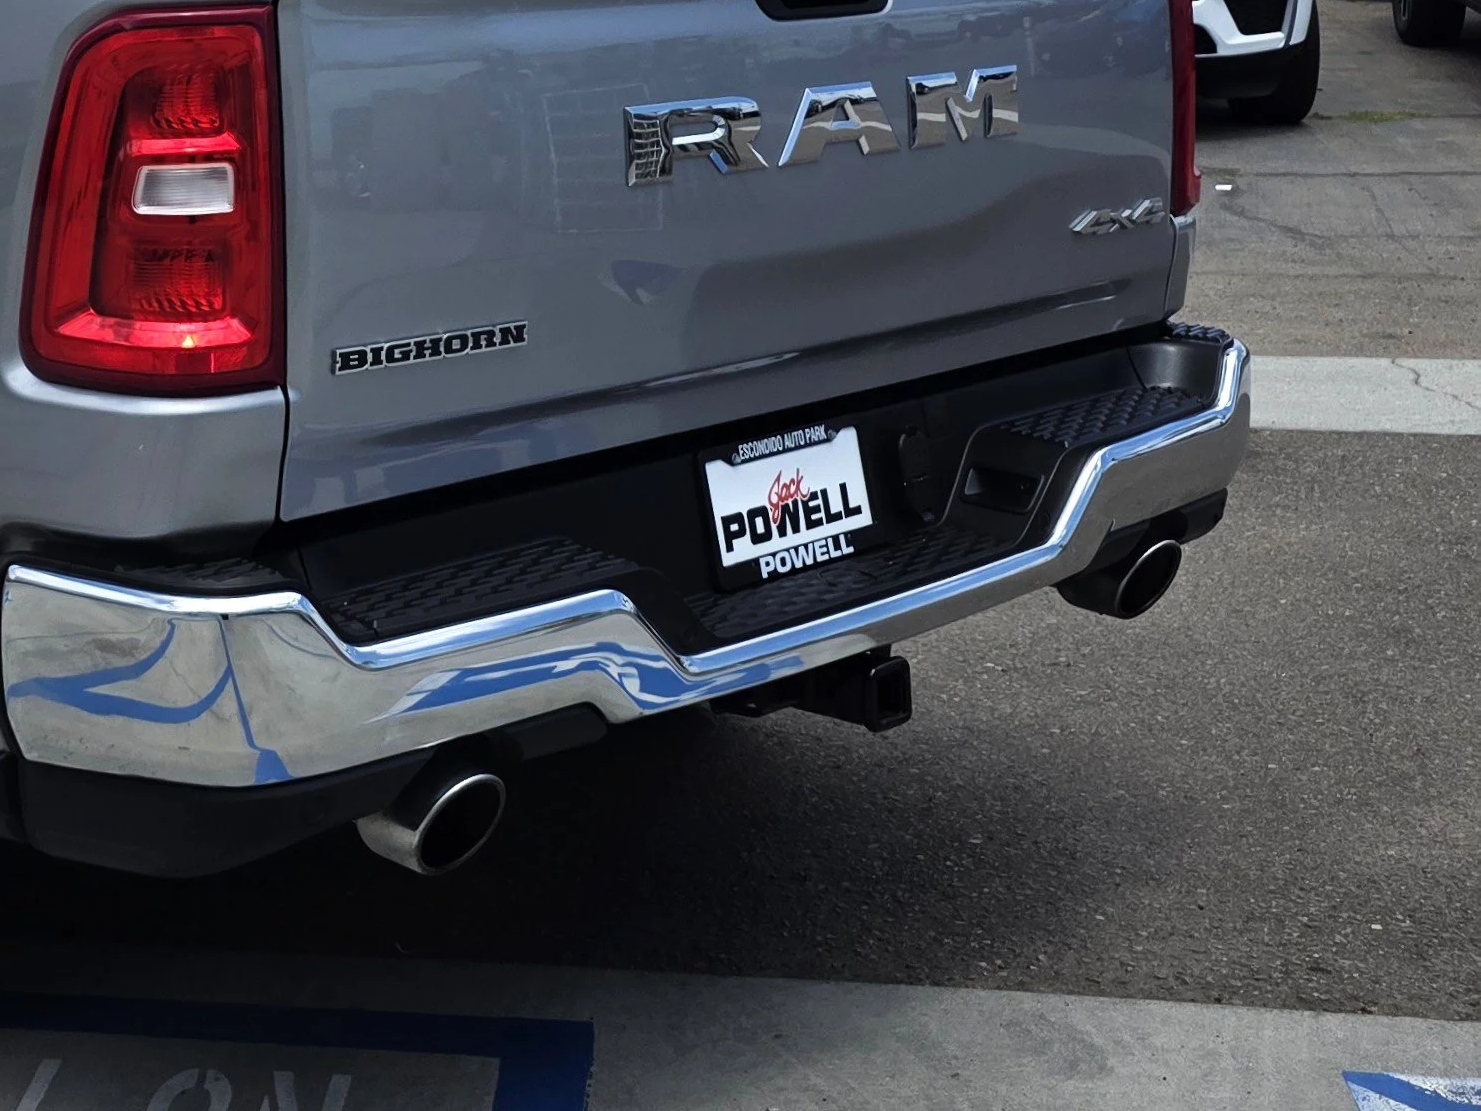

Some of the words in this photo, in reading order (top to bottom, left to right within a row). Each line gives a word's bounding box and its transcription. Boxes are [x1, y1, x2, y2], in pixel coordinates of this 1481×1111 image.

[623, 65, 1019, 187] RAM
[333, 320, 528, 375] BIGHORN
[738, 435, 784, 460] ESCONDIDO
[784, 429, 805, 448] AUTO
[805, 424, 827, 444] PARK
[720, 482, 863, 554] POWELL
[767, 467, 810, 526] Jack
[759, 534, 855, 579] POWELL
